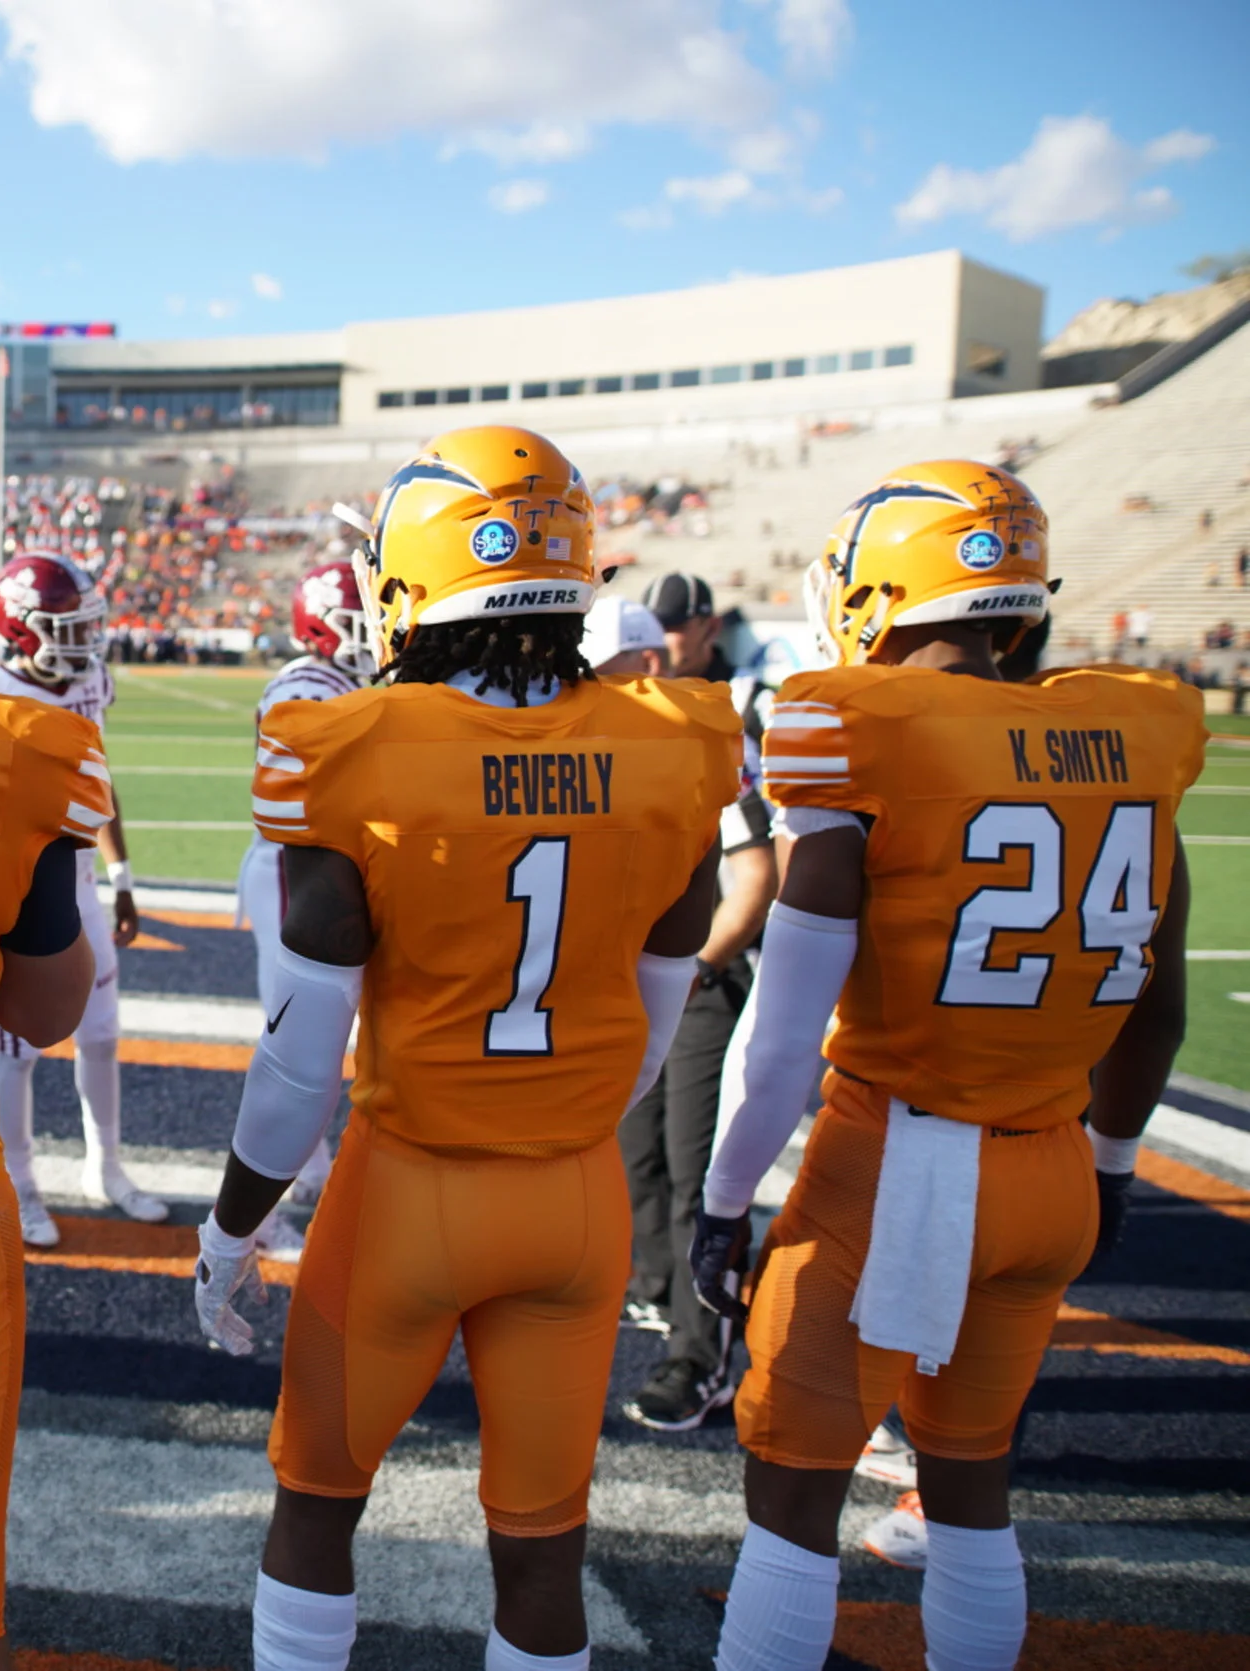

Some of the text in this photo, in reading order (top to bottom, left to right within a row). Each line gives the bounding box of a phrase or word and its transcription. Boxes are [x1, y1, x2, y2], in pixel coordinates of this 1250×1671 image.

[484, 590, 578, 609] MINERS
[967, 594, 1043, 612] MINERS
[482, 753, 613, 816] BEVERLY
[1008, 728, 1129, 783] K. SMITH
[933, 801, 1160, 1009] 24
[483, 835, 571, 1057] 1
